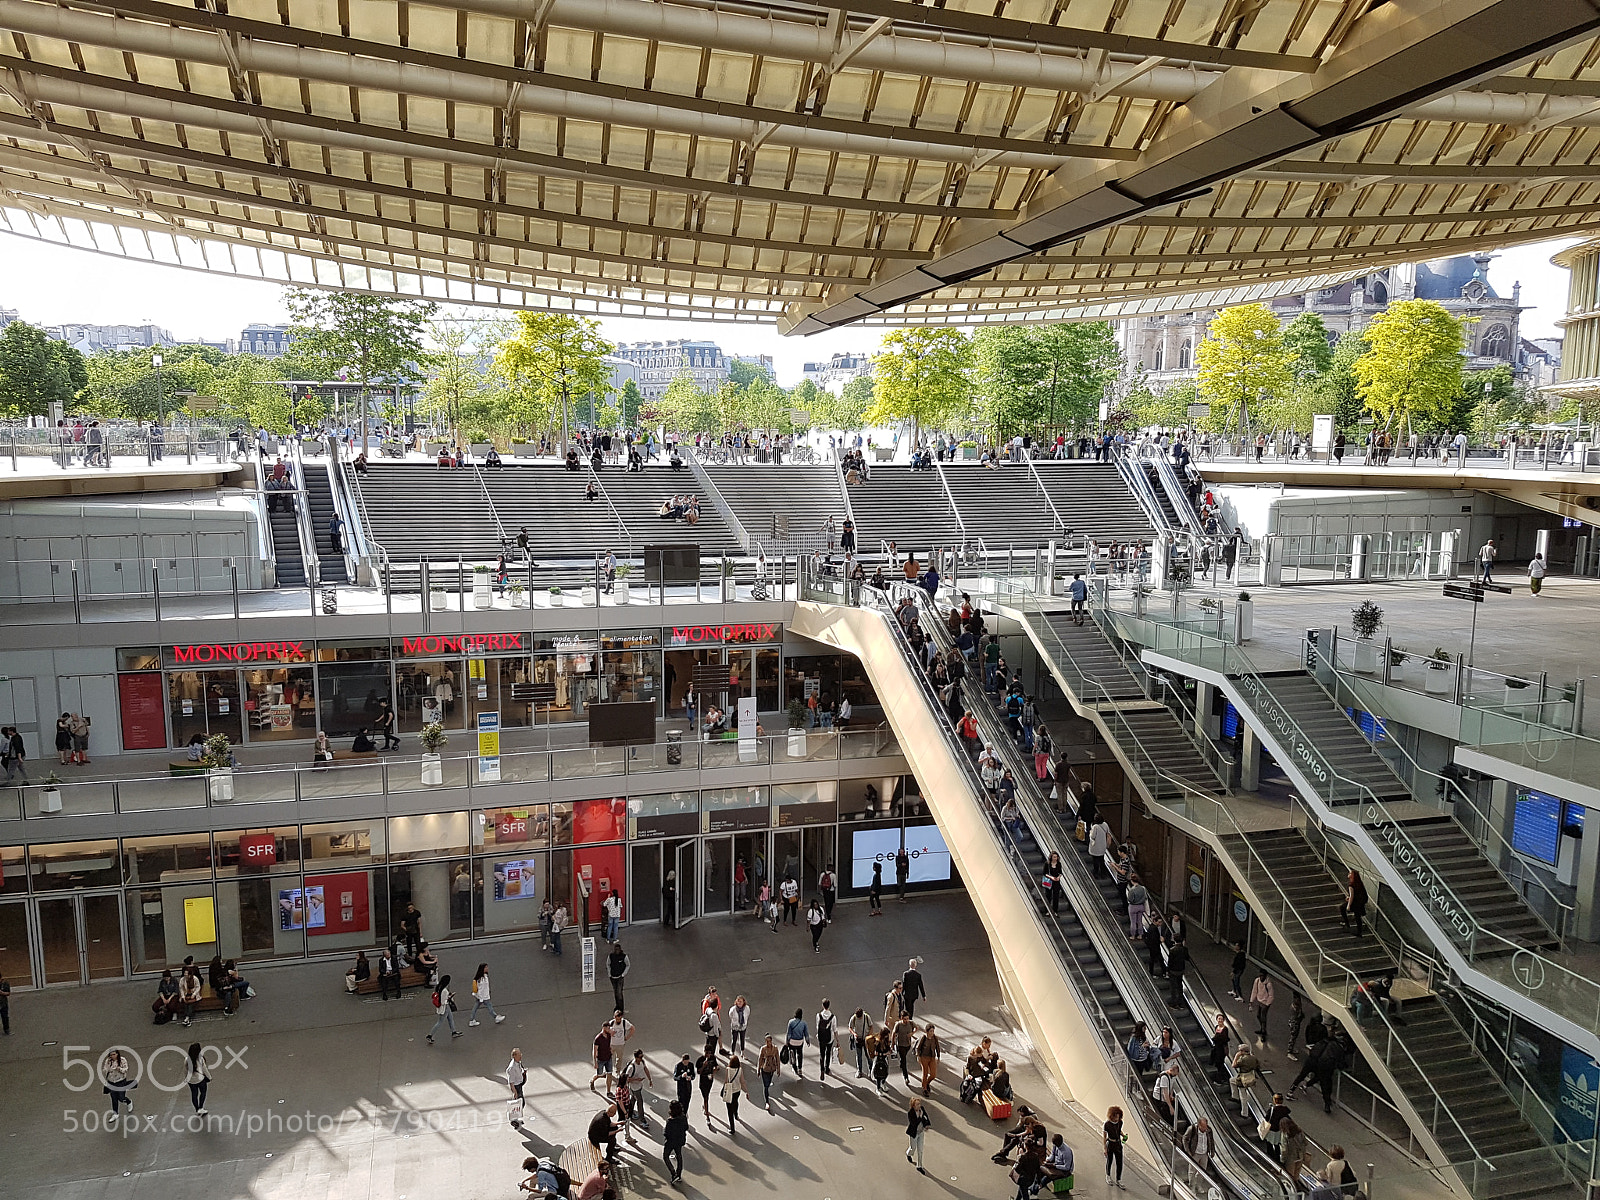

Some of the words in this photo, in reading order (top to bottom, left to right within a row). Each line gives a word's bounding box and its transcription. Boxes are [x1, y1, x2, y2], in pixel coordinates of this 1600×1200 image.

[402, 632, 522, 653] MONOPRIX
[673, 623, 775, 642] MONOPRIX
[173, 641, 305, 663] MONOPRIX
[1229, 659, 1262, 698] OUVERT
[502, 822, 526, 834] SFR
[247, 844, 274, 857] SFR
[1366, 805, 1384, 828] DU
[1381, 825, 1415, 867] LUNDI
[1411, 866, 1431, 887] AU
[1428, 885, 1473, 940] SAMEDI
[1561, 1095, 1595, 1120] adida
